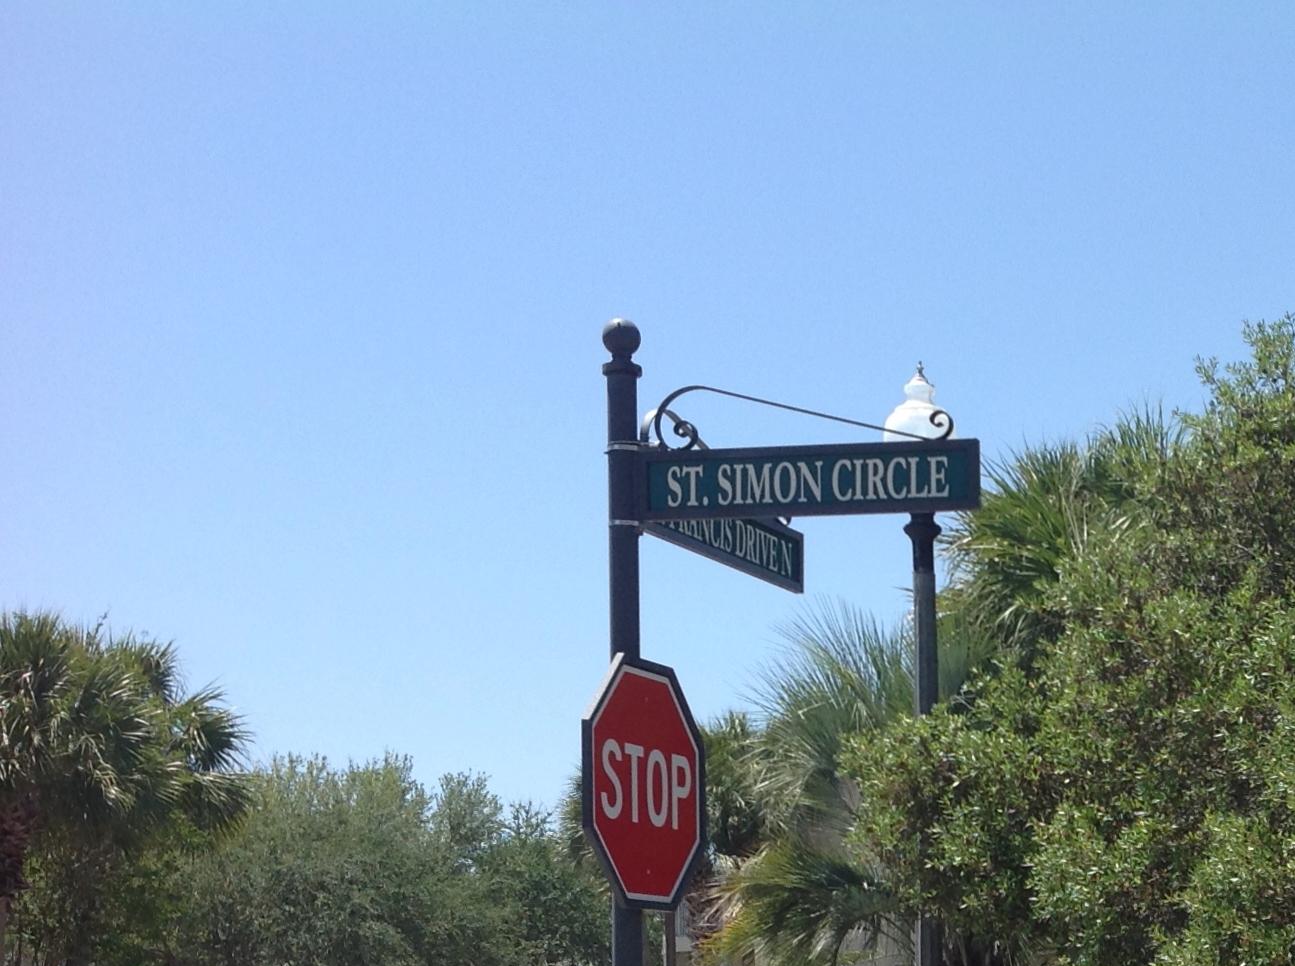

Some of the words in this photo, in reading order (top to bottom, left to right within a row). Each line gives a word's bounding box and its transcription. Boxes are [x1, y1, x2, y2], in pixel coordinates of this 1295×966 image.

[667, 465, 709, 508] ST.
[717, 461, 824, 505] SIMON
[831, 456, 950, 501] CIRCLE
[667, 518, 733, 552] ANCIS
[735, 520, 779, 571] DRIVE
[780, 540, 794, 577] N
[600, 738, 692, 830] STOP
